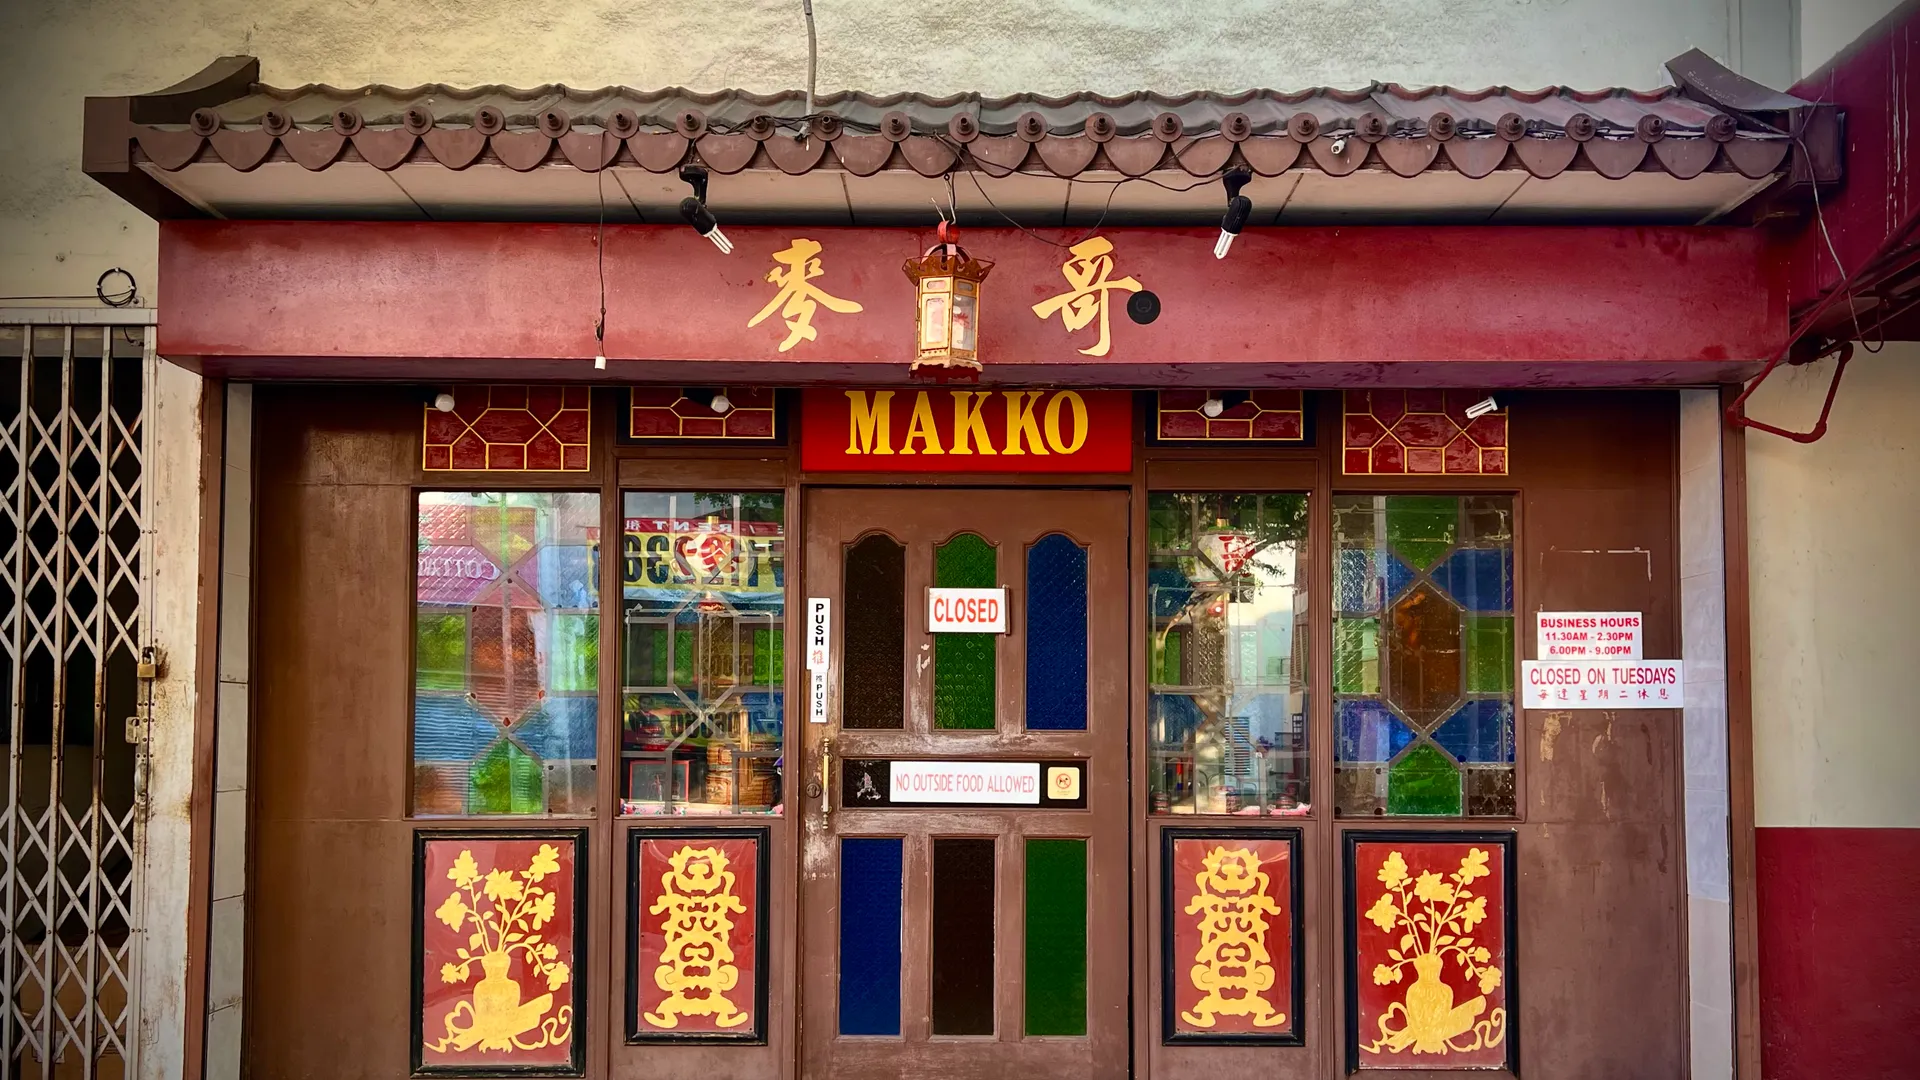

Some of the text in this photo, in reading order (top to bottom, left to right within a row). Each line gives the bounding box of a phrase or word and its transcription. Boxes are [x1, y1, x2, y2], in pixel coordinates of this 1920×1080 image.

[845, 390, 1089, 455] MAKKO
[934, 597, 999, 623] CLOSED
[815, 603, 824, 646] PUSH
[1540, 617, 1640, 628] BUSINESS HOURS
[1545, 631, 1588, 641] 11.30AM
[1597, 631, 1633, 641] 2.30PM
[1549, 645, 1586, 655] 6.00PM
[1595, 645, 1632, 655] 9.00PM
[1530, 667, 1676, 685] CLOSED ON TUESDAYS
[815, 684, 823, 716] PUSH
[895, 773, 1035, 793] NO OUTSIDE FOOD ALLOWED
